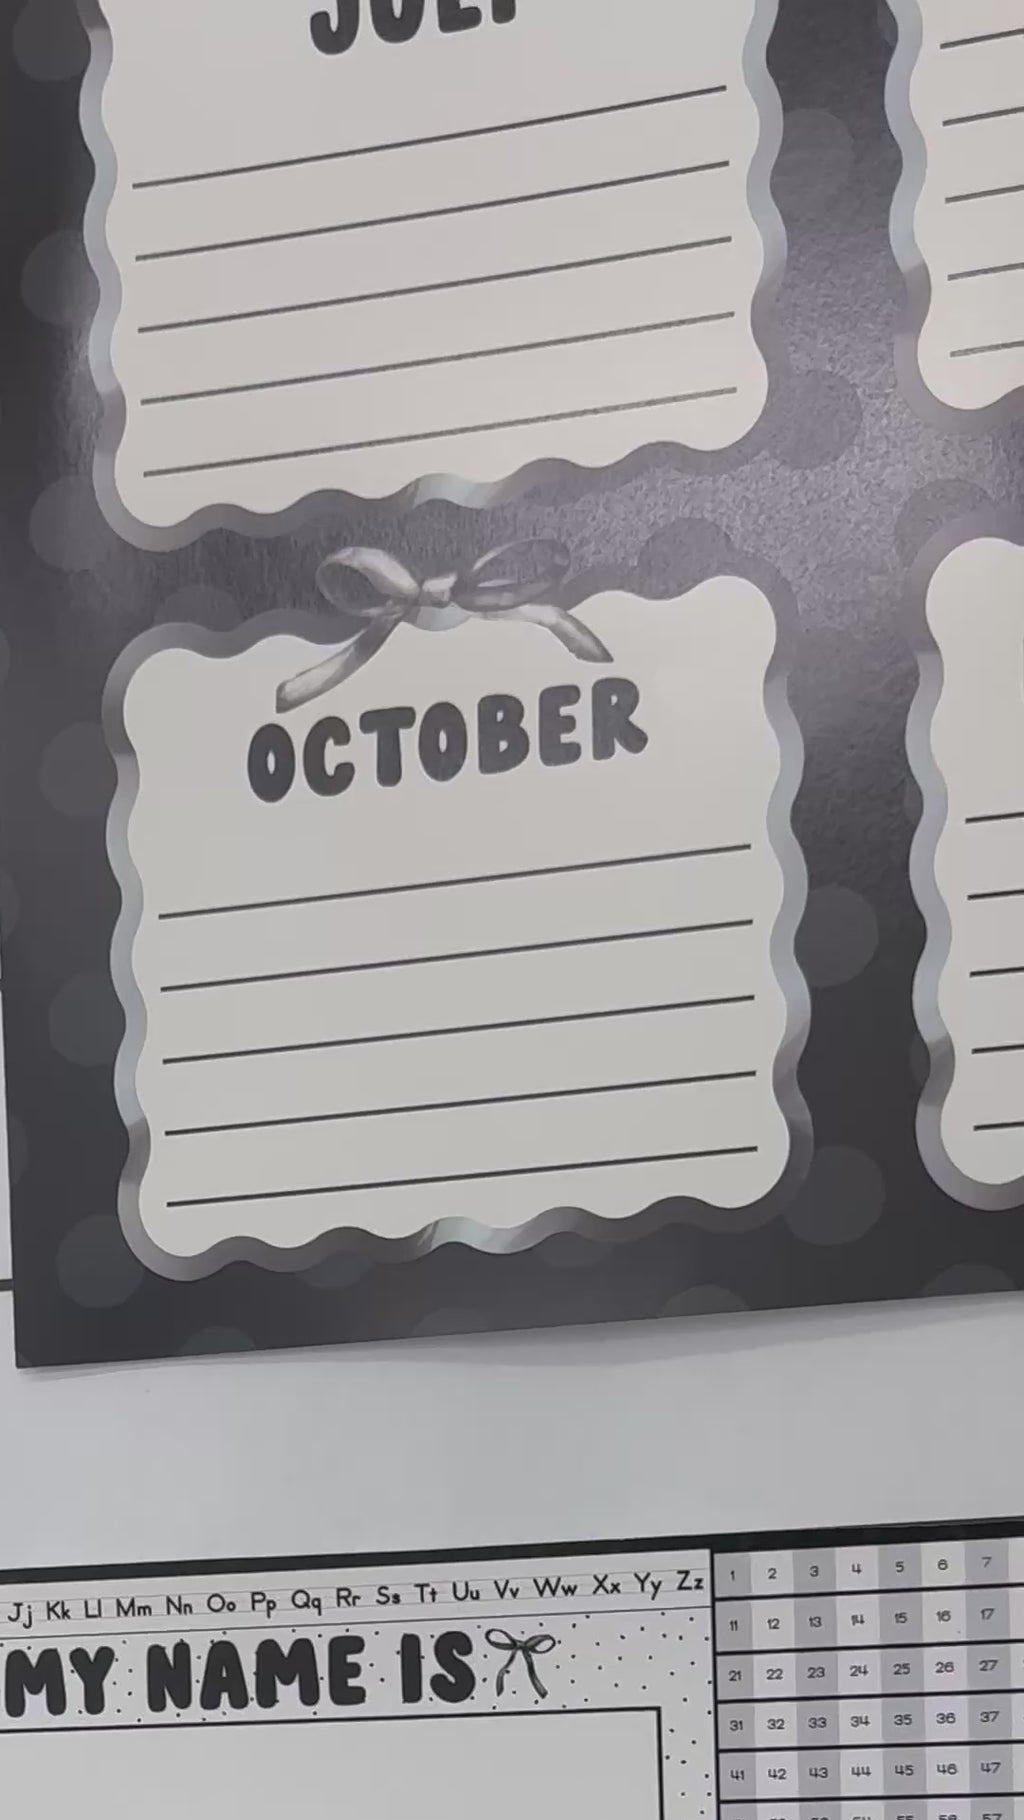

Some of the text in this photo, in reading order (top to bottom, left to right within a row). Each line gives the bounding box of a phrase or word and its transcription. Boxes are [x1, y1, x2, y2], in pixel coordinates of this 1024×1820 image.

[247, 676, 647, 803] OCTOBER
[730, 1556, 993, 1581] 1 2 3 4 5 6 7
[7, 1602, 33, 1630] Jj
[46, 1600, 71, 1621] Kk
[83, 1598, 102, 1619] Ll
[115, 1597, 153, 1618] Mm
[165, 1594, 193, 1616] Nn
[206, 1592, 237, 1614] Oo
[250, 1591, 277, 1619] Pp
[290, 1588, 322, 1617] Qq
[336, 1586, 362, 1608] Rr
[375, 1585, 401, 1606] Ss
[413, 1582, 438, 1604] Tt
[452, 1580, 481, 1602] Uu
[493, 1579, 520, 1600] Vv
[532, 1576, 578, 1598] Ww
[592, 1573, 621, 1595] Xx
[633, 1571, 663, 1601] Yy
[676, 1568, 705, 1593] Zz
[729, 1607, 995, 1632] 11 12 13 14 15 16 17
[4, 1645, 114, 1717] MY
[147, 1634, 366, 1711] NAME
[400, 1630, 475, 1703] IS
[728, 1659, 999, 1682] 21 22 23 24 25 26 27
[729, 1710, 1000, 1732] 31 32 33 34 35 36 37
[730, 1761, 1002, 1781] 41 42 43 44 45 46 47
